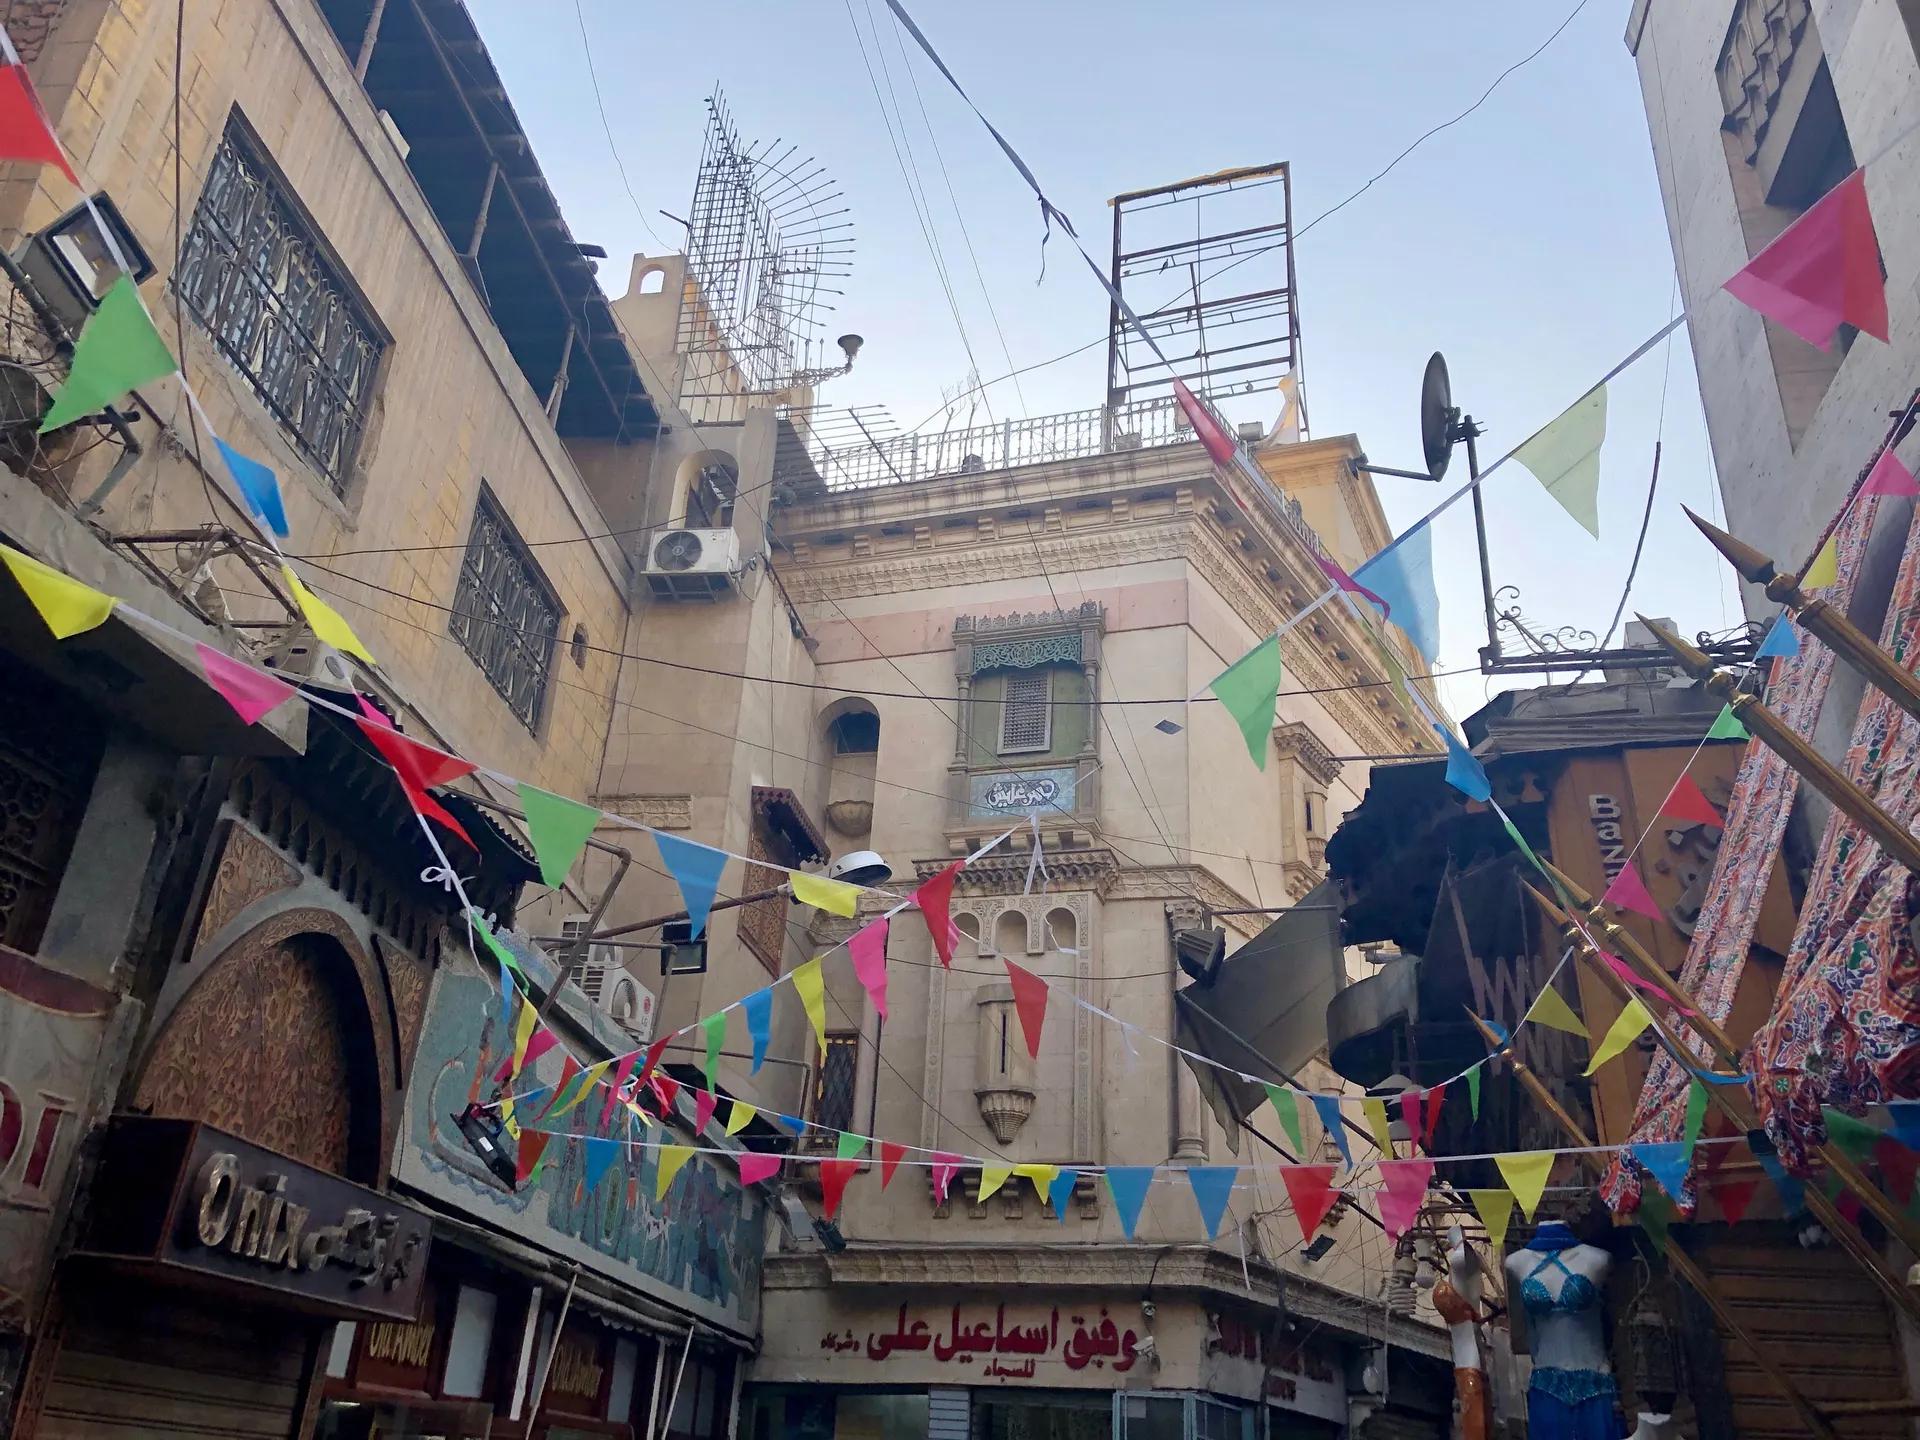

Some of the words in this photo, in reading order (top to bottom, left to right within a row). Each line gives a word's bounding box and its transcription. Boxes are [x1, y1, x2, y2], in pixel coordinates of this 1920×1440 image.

[197, 1152, 310, 1271] Onix
[934, 1301, 1060, 1363] اسماعيل
[1064, 1307, 1138, 1372] وفيق
